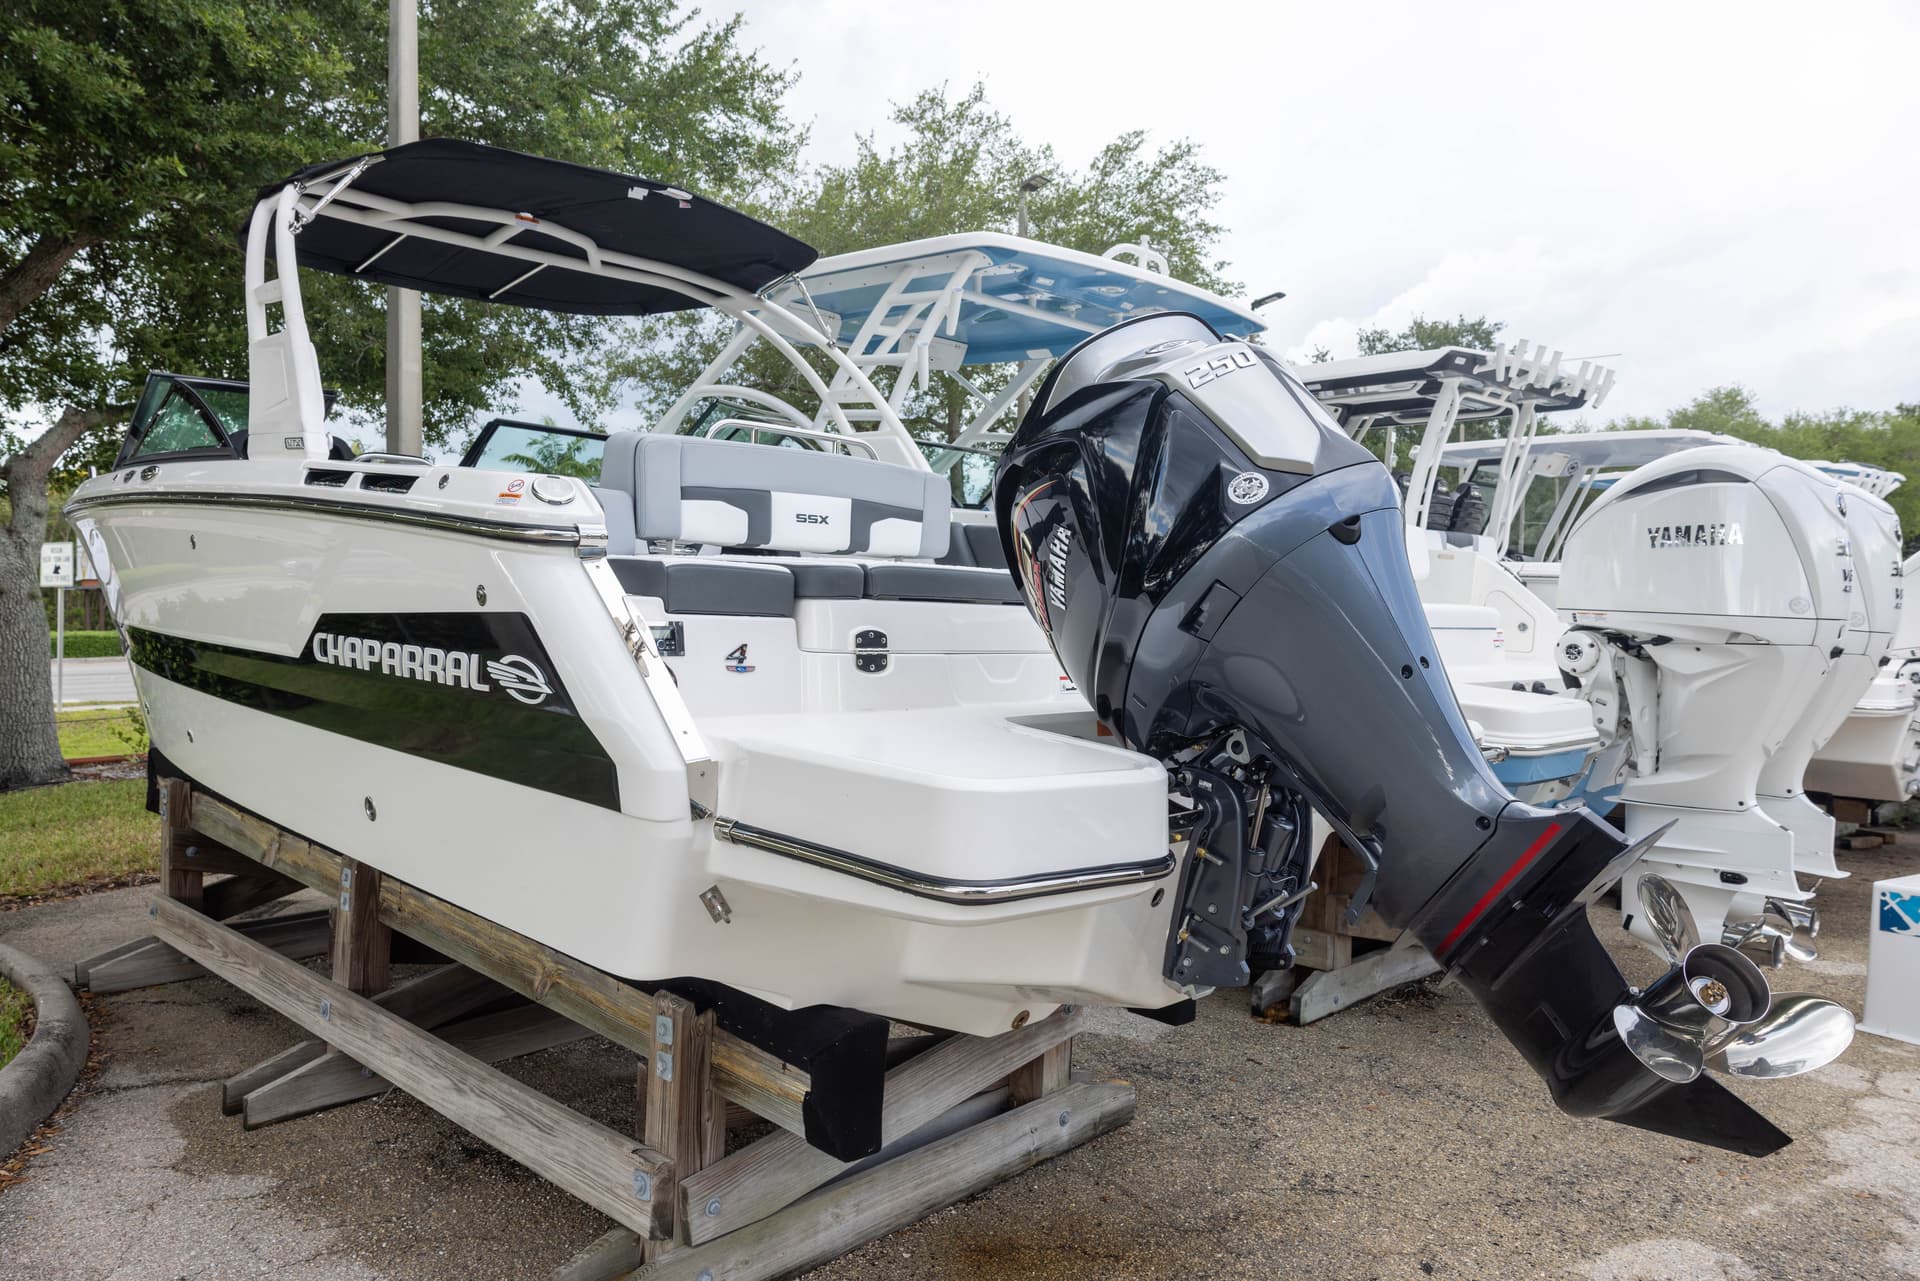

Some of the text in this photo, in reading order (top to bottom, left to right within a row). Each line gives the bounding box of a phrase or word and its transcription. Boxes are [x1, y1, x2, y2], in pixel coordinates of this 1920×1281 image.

[1184, 348, 1257, 389] 250
[795, 513, 830, 525] SSX
[1647, 522, 1744, 549] YAMAHA
[1048, 522, 1073, 611] YAMAHA
[312, 631, 491, 693] CHAPARRAL
